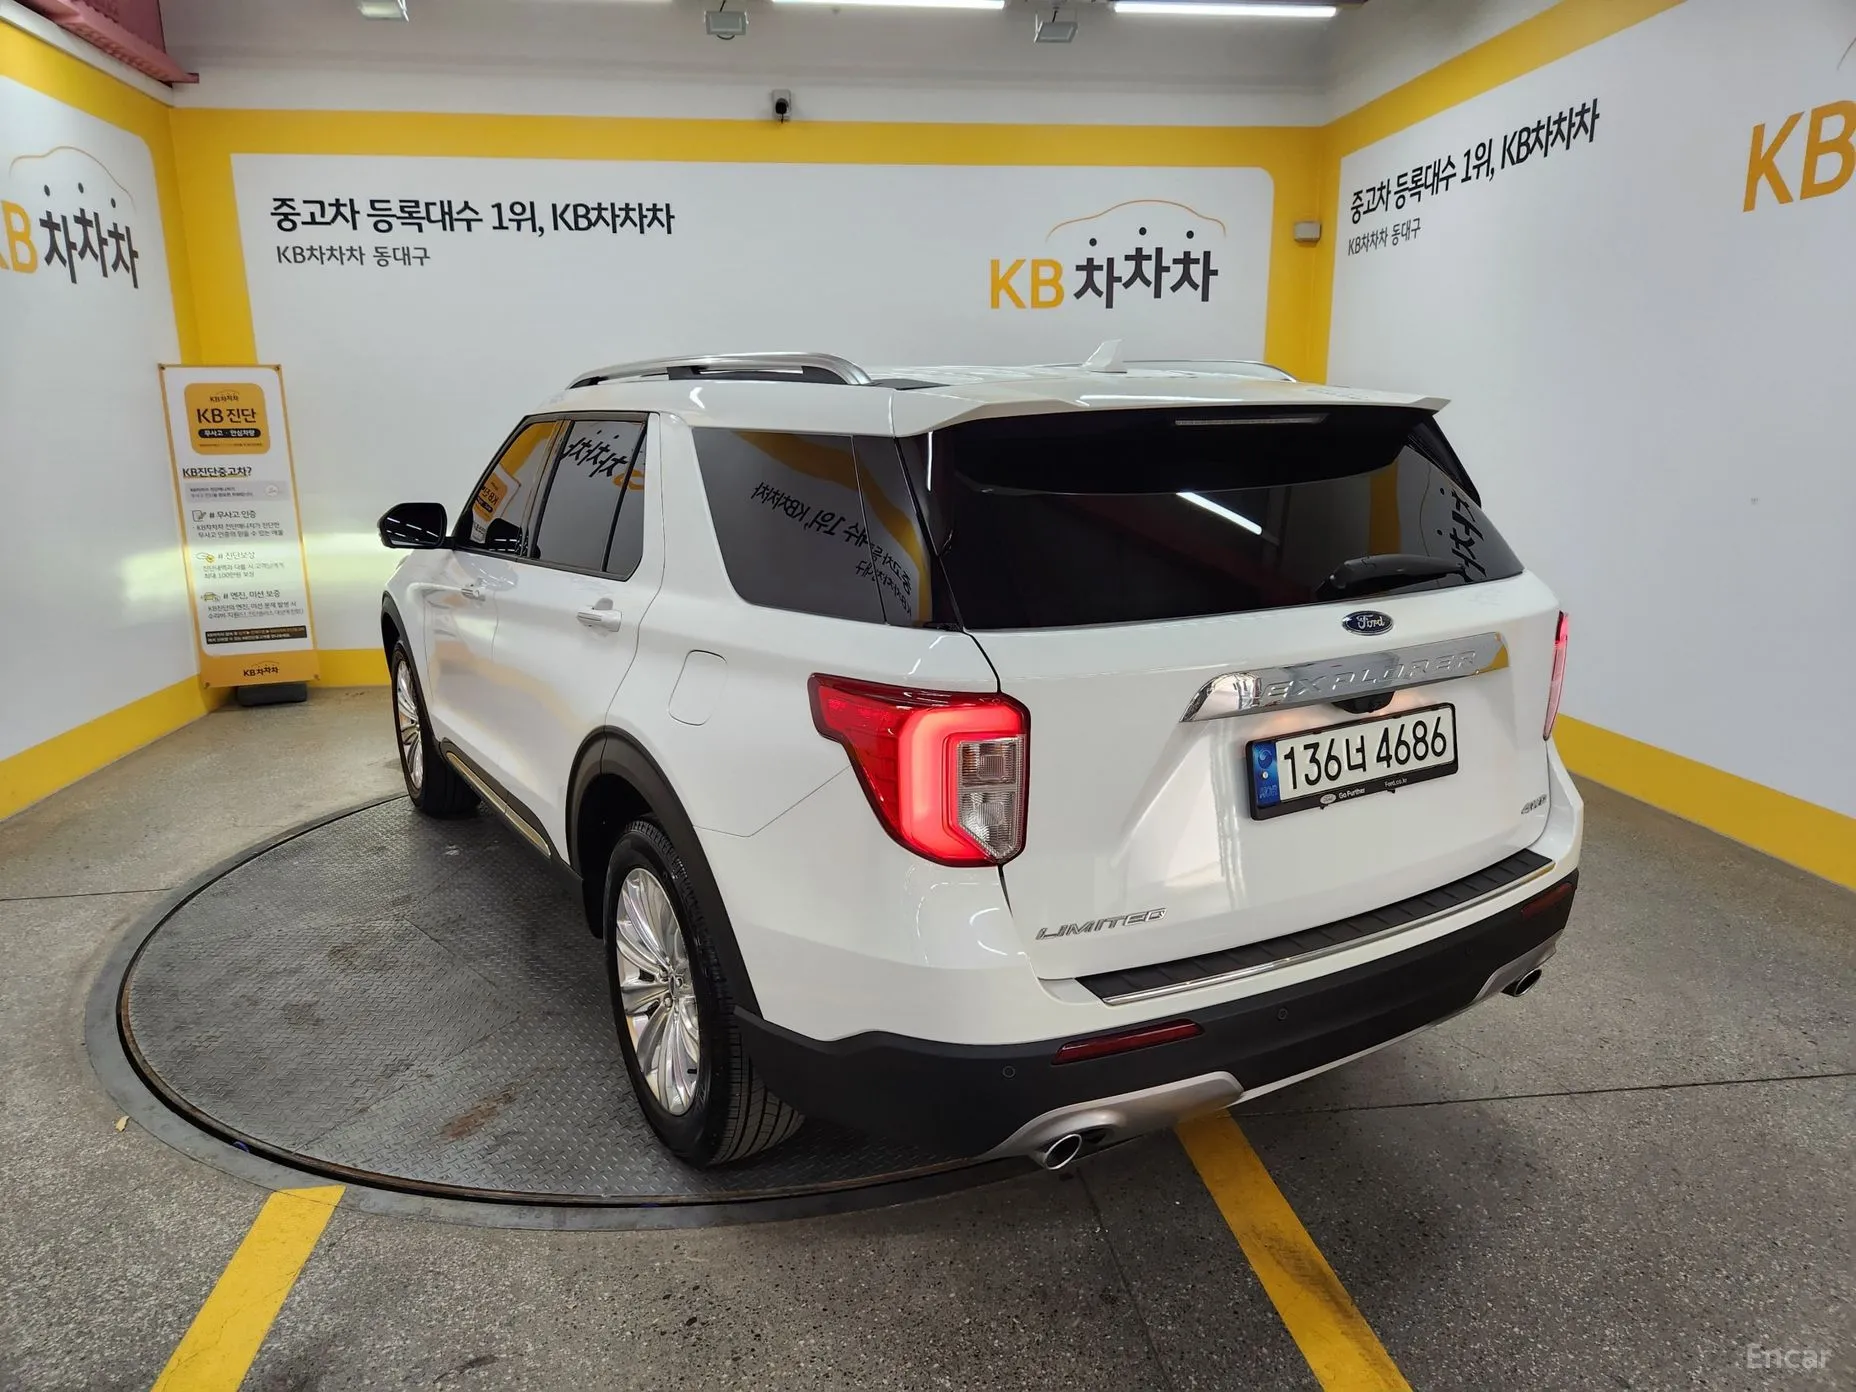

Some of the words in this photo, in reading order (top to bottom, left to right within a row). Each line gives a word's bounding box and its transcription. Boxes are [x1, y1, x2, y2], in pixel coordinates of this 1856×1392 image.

[1351, 178, 1392, 225] 중고차
[1393, 154, 1457, 210] 등록대수
[1460, 138, 1496, 183] 1위,
[1500, 98, 1600, 170] KB차차차
[1743, 100, 1856, 213] KB
[0, 182, 139, 289] B차차차
[270, 197, 360, 233] 중고차
[366, 199, 483, 234] 등록대수
[492, 200, 545, 237] 1위,
[552, 202, 675, 235] KB차차차
[1348, 226, 1388, 256] KB차차차
[1391, 217, 1421, 247] 동대구
[276, 245, 366, 266] KB차차차
[373, 246, 431, 267] 동대구
[196, 408, 224, 424] KB
[226, 408, 257, 424] 진단
[182, 467, 252, 479] KB진단중고차?
[217, 511, 240, 519] 무사고
[241, 510, 257, 519] 인증
[1356, 614, 1386, 629] Ford
[1260, 650, 1477, 702] EXPLORER
[1283, 734, 1367, 790] 136너
[1375, 716, 1448, 768] 4686
[1035, 907, 1167, 941] LIMITED
